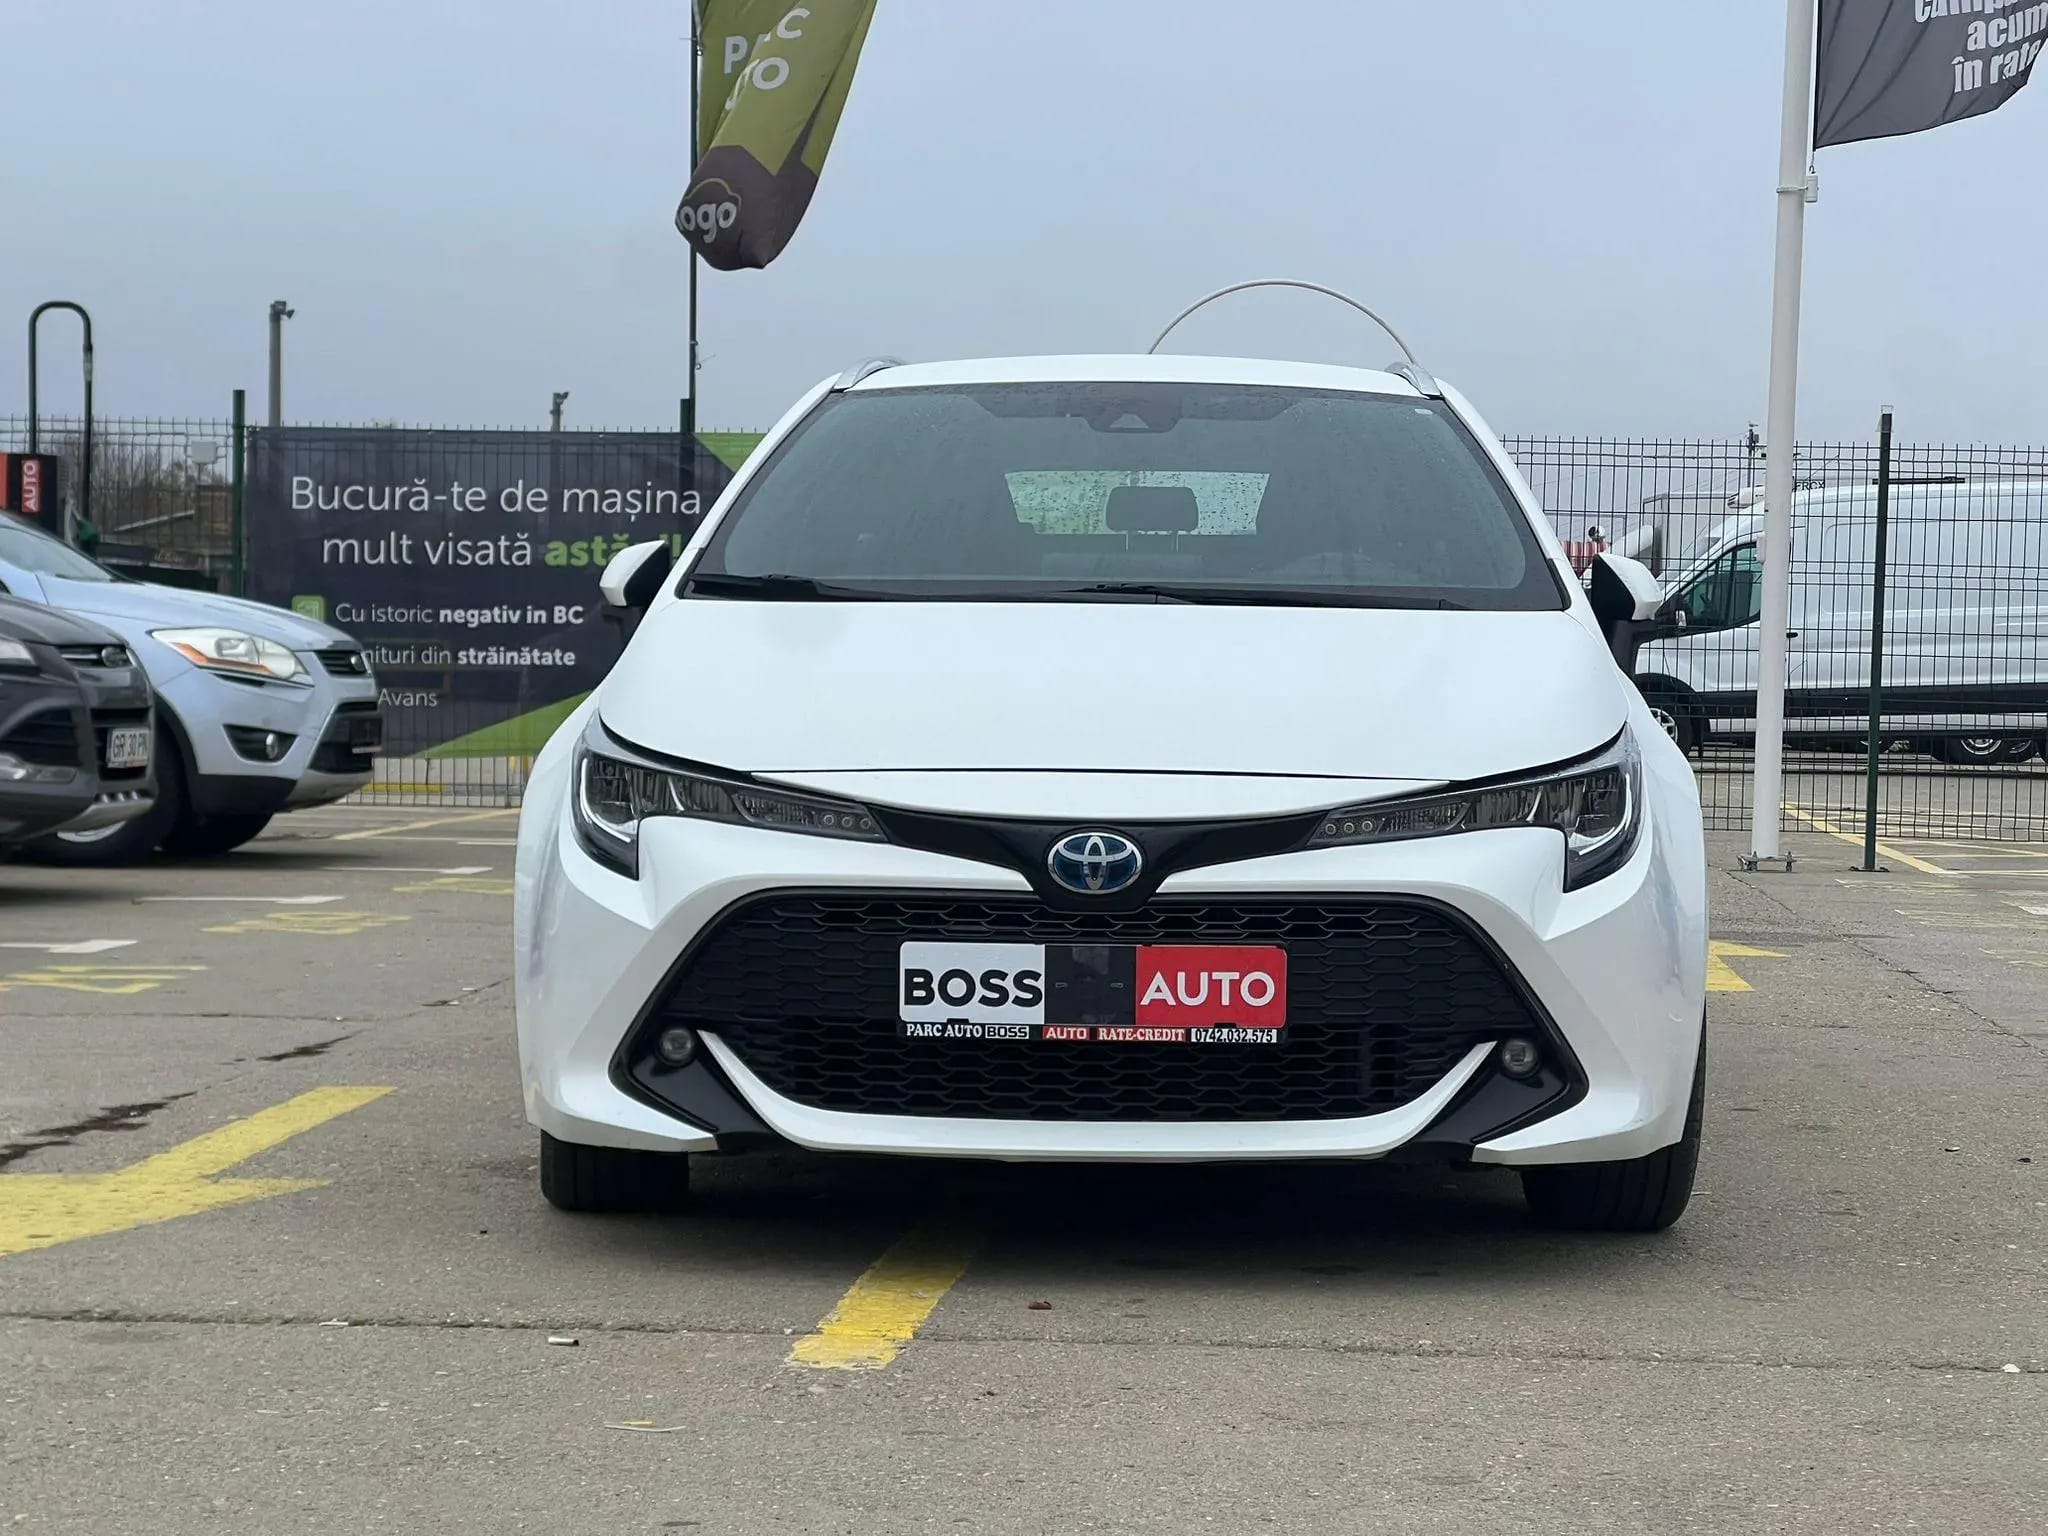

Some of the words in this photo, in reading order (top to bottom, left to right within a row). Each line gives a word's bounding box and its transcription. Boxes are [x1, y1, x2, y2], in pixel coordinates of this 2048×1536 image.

[1967, 2, 2048, 51] acum
[1951, 56, 1984, 93] în
[23, 462, 38, 511] AUTO
[291, 475, 488, 513] Bucură-te
[500, 479, 548, 513] de
[562, 481, 701, 521] mașina
[322, 531, 413, 565] mult
[424, 532, 531, 566] visată
[335, 603, 364, 623] Cu
[371, 603, 433, 623] istoric
[439, 605, 521, 628] negativ
[526, 605, 547, 624] in
[553, 605, 584, 624] BC
[421, 645, 451, 665] din
[457, 646, 576, 666] străinătate
[378, 687, 438, 707] Avans
[904, 968, 1044, 1008] BOSS
[1140, 970, 1275, 1007] AUTO
[906, 1023, 942, 1037] PARC
[944, 1024, 983, 1038] AUTO
[986, 1025, 1028, 1039] BOSS
[1045, 1027, 1088, 1040] AUTO
[1098, 1028, 1186, 1042] RATE-CREDIT
